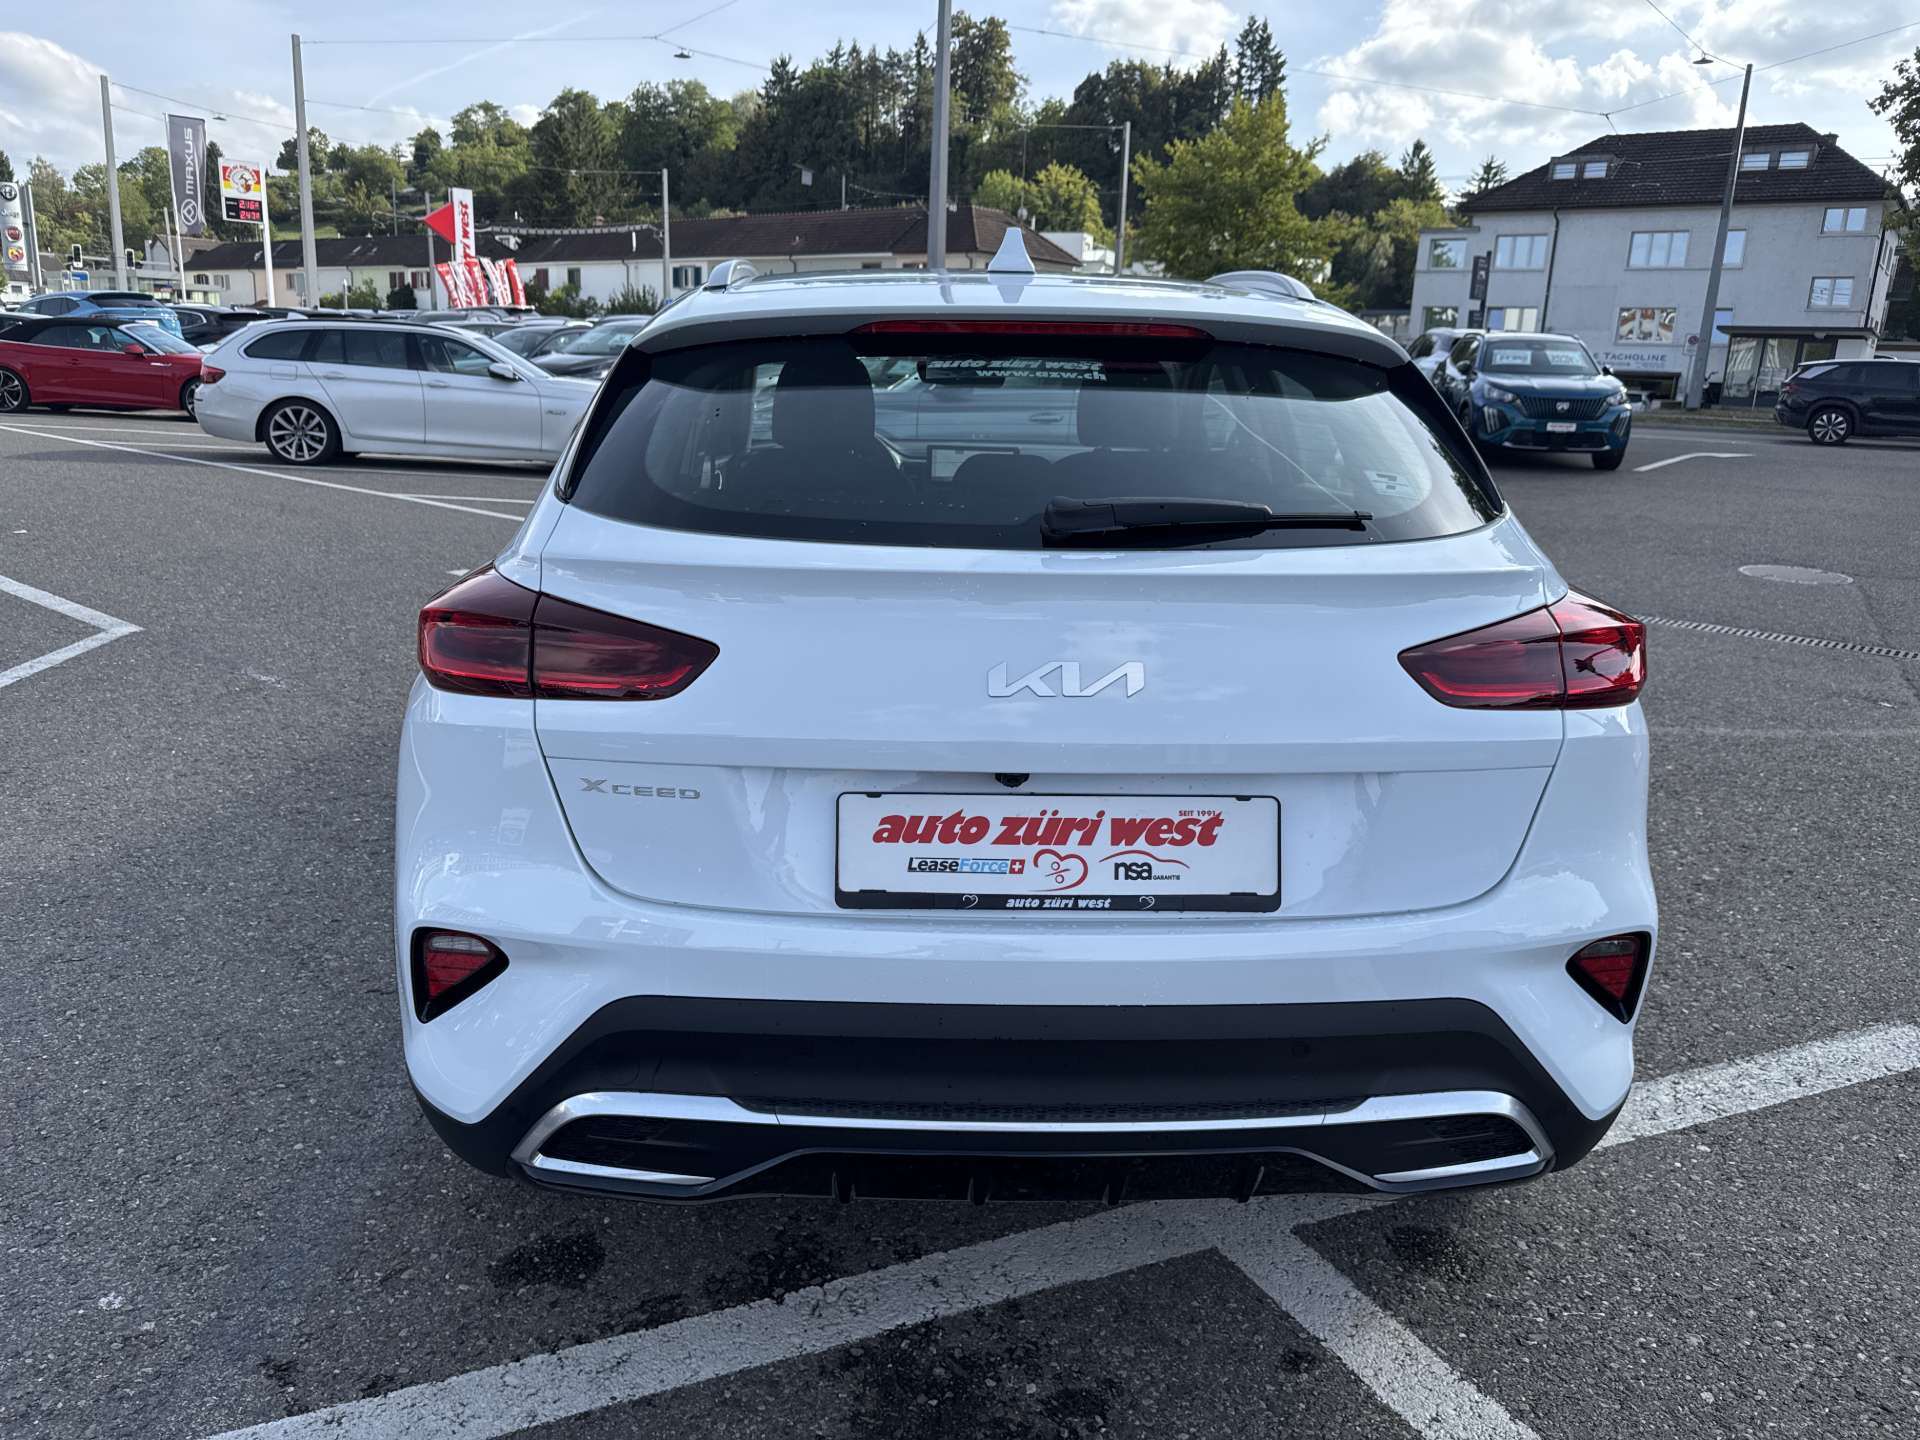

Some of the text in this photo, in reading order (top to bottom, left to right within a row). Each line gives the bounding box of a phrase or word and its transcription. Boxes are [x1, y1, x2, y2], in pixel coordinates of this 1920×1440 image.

[183, 127, 194, 195] MAXUS
[1603, 352, 1667, 361] TACHOLINE
[872, 808, 1224, 846] auto züri west
[907, 857, 1009, 873] LeaseForce
[1114, 862, 1152, 880] nsa
[1006, 897, 1112, 908] auto züri west
